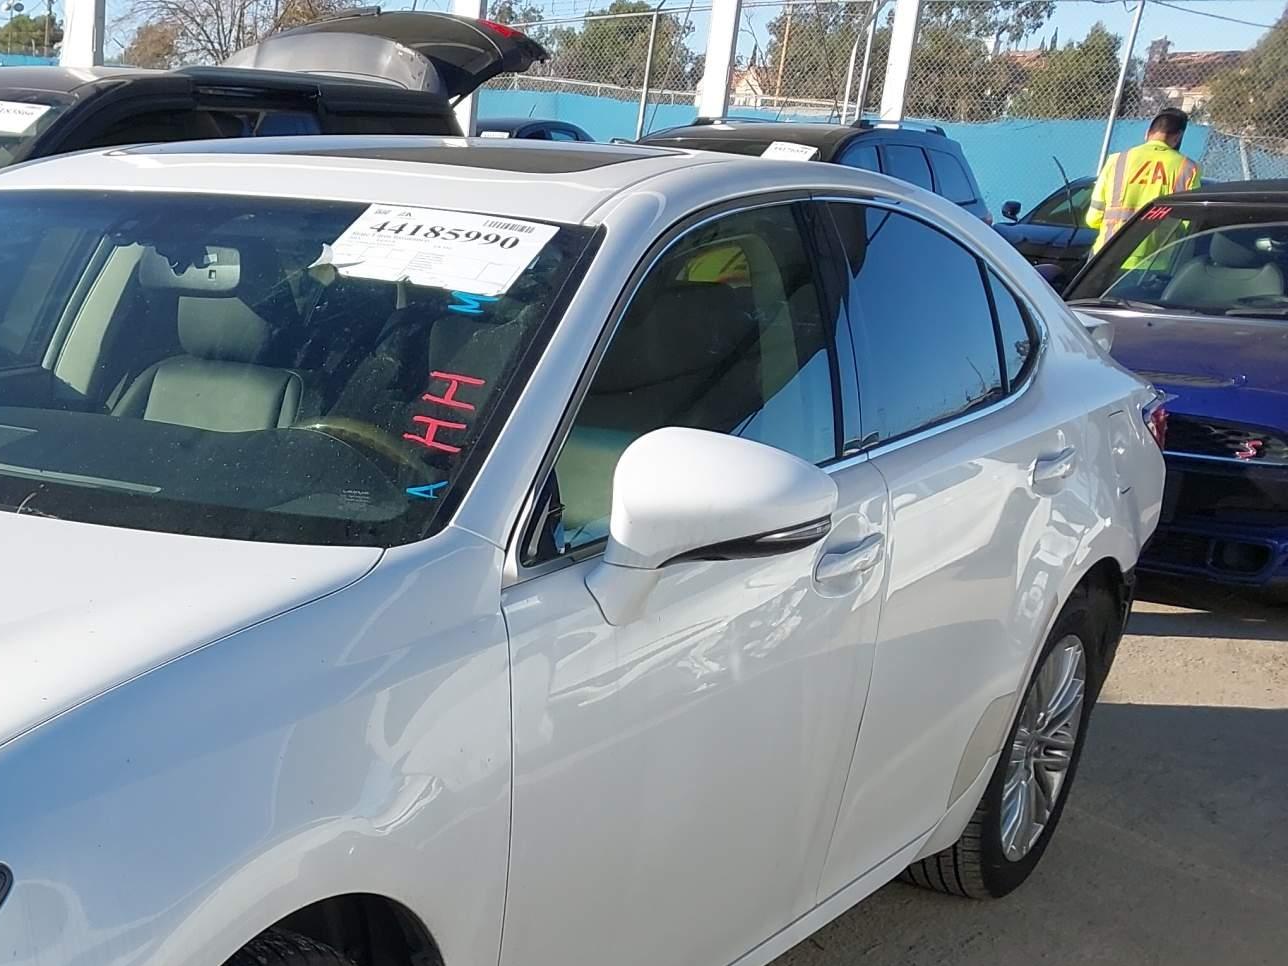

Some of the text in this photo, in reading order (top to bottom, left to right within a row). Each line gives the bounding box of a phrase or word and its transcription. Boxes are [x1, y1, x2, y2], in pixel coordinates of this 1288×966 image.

[1140, 206, 1173, 220] HH
[369, 220, 520, 250] 44185990
[406, 480, 449, 499] A
